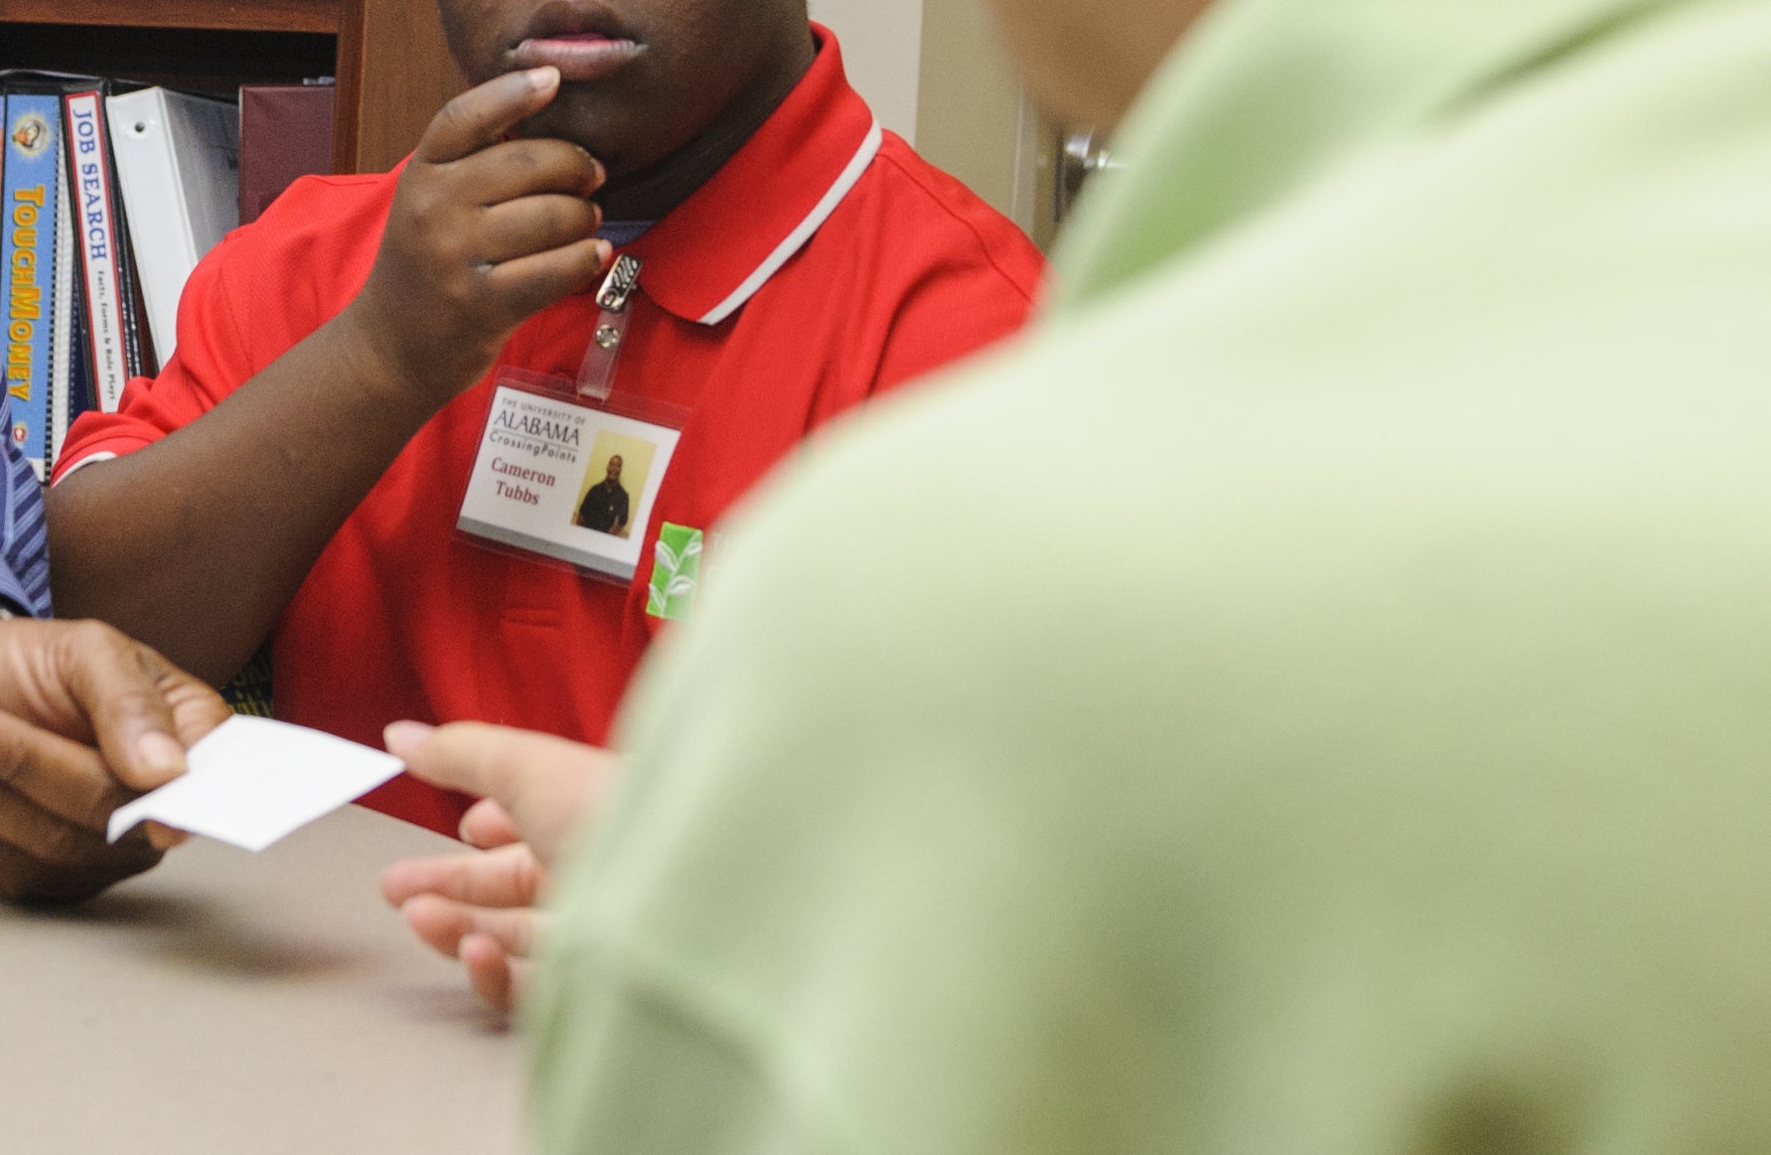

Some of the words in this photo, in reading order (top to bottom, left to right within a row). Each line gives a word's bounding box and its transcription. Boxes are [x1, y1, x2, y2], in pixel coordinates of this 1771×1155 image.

[73, 109, 98, 154] JOB
[82, 162, 108, 261] SEARCH
[493, 409, 580, 447] ALABAMA
[502, 396, 518, 409] THE
[520, 402, 572, 422] UNIVERSITY
[573, 415, 587, 426] OF
[489, 430, 577, 464] CrossingPoints
[490, 456, 557, 487] Cameron
[496, 479, 541, 506] Tubbs
